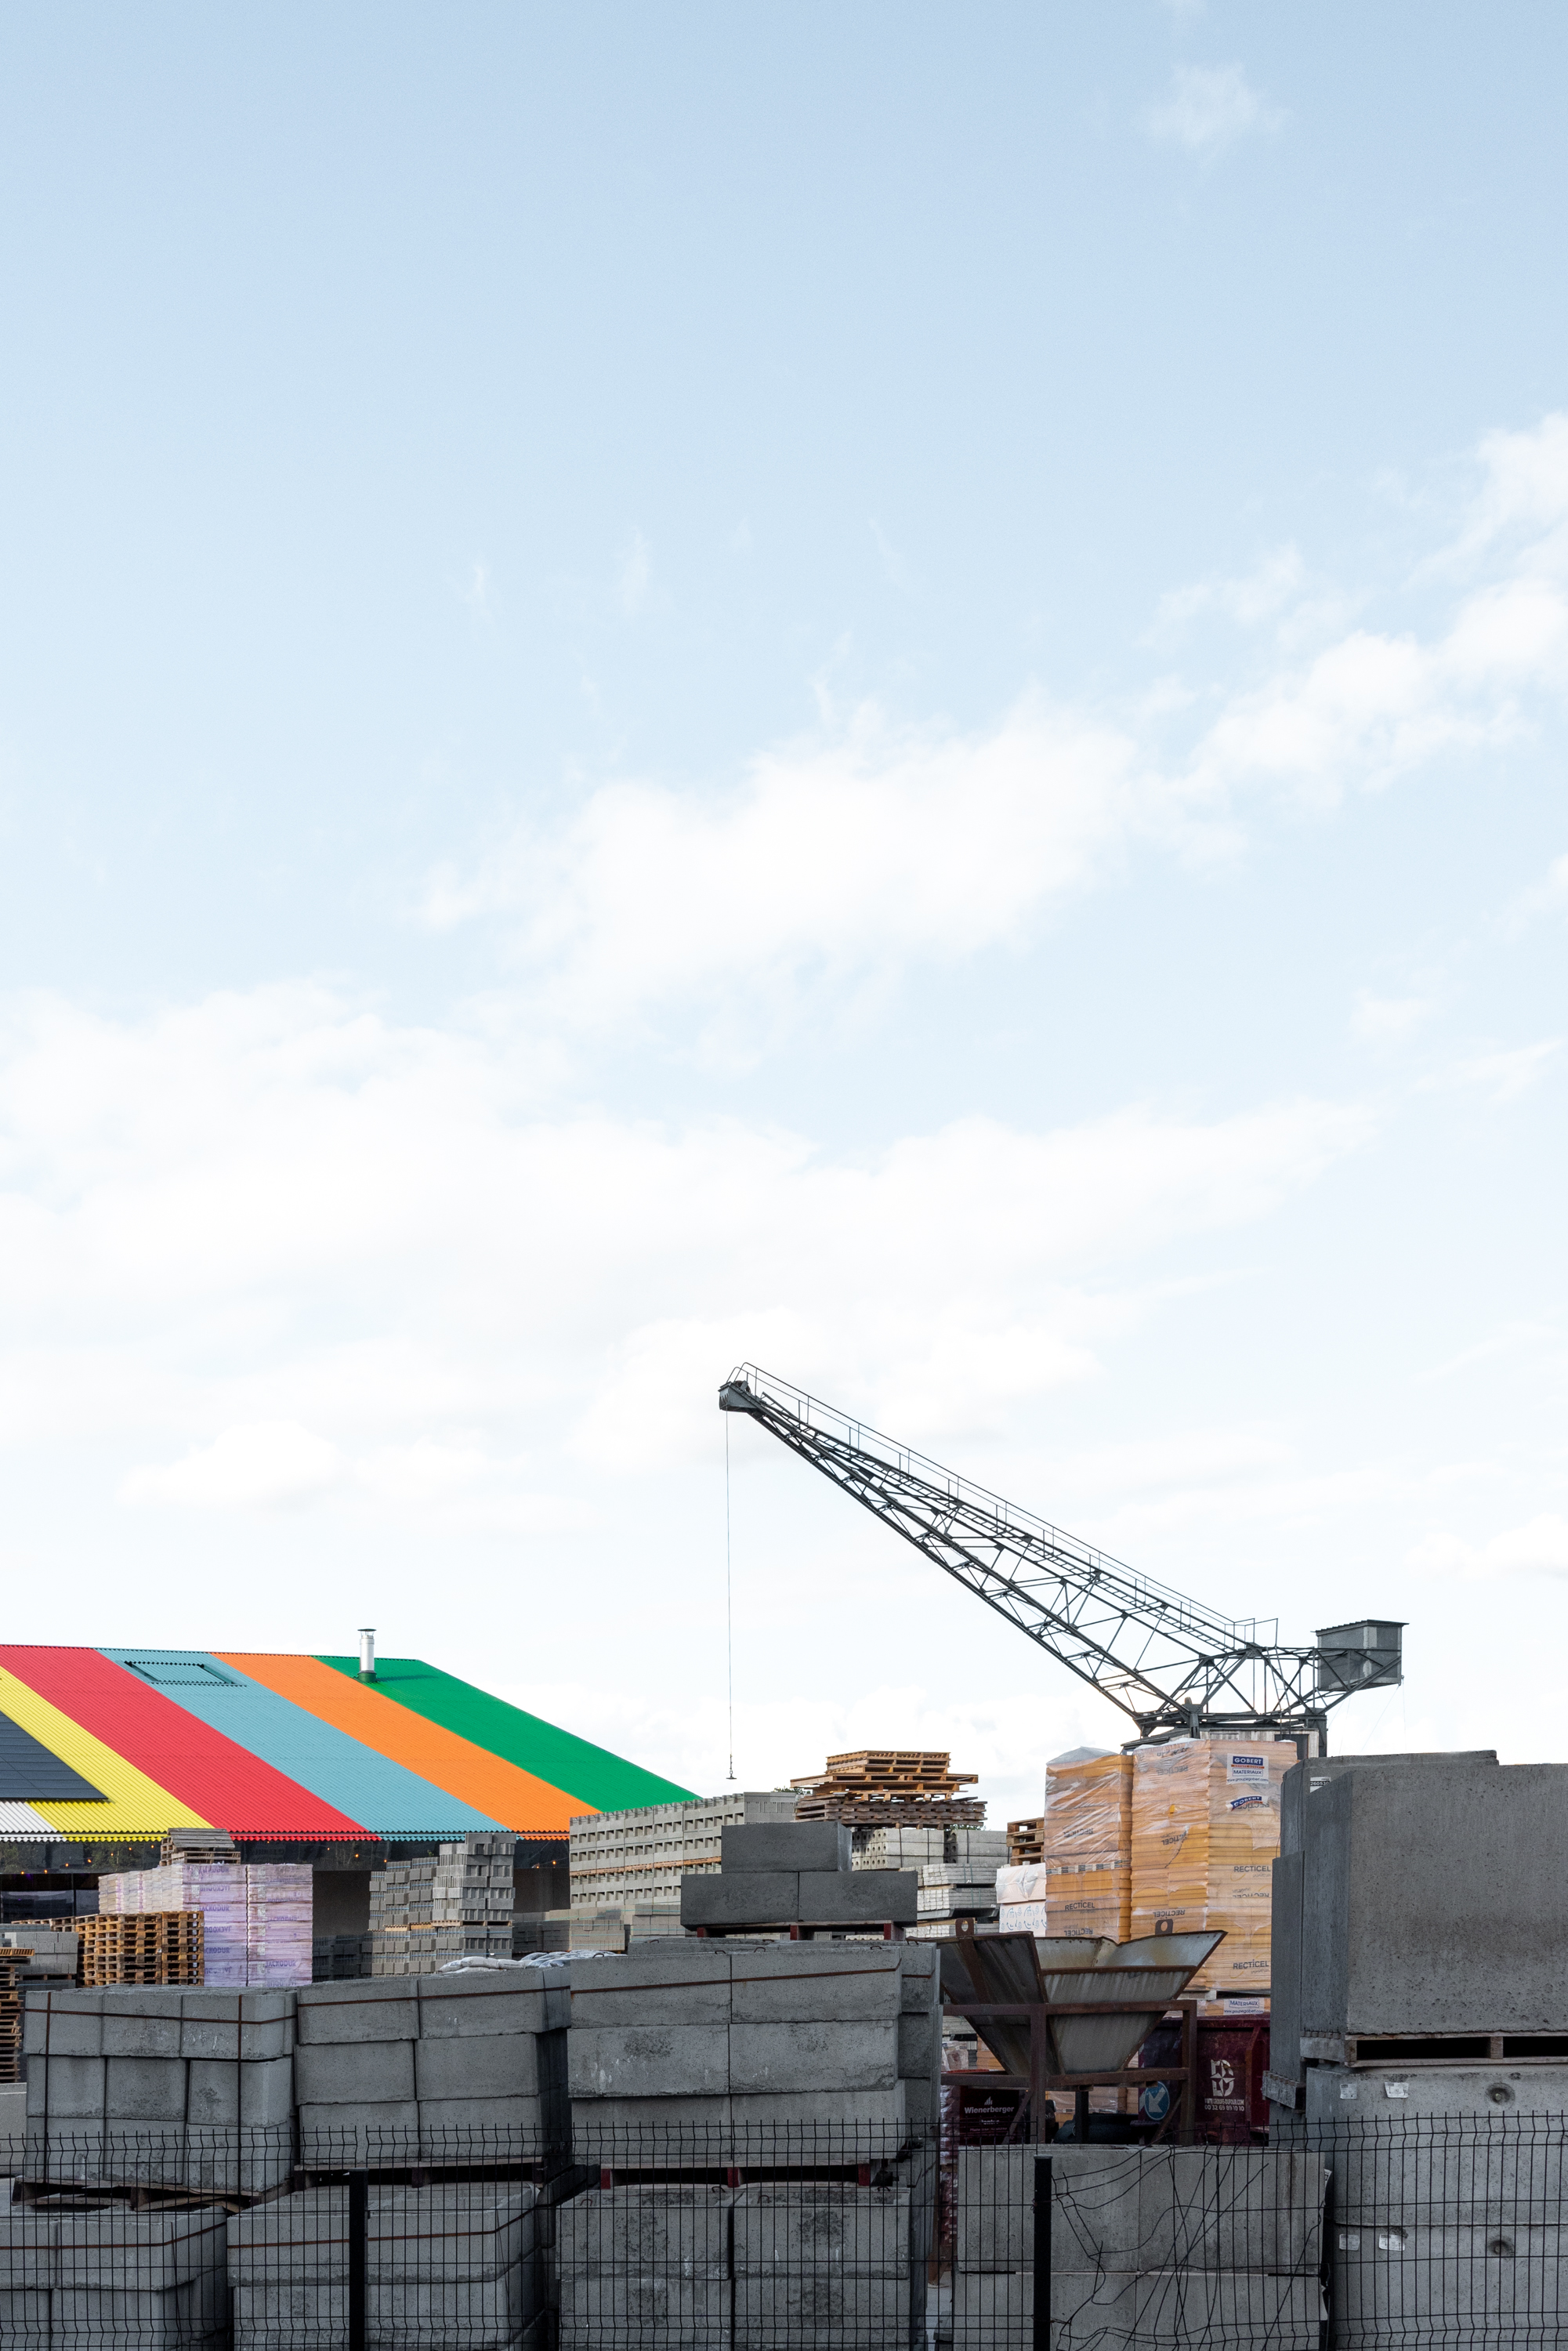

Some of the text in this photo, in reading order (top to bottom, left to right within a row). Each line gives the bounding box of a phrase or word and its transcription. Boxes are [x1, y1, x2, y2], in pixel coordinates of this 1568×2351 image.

[1065, 1900, 1095, 1911] RECTICEL
[1153, 1909, 1186, 1918] RECTICEL
[1064, 1928, 1093, 1936] RECTICEL
[1233, 1959, 1269, 1969] RECTICEL
